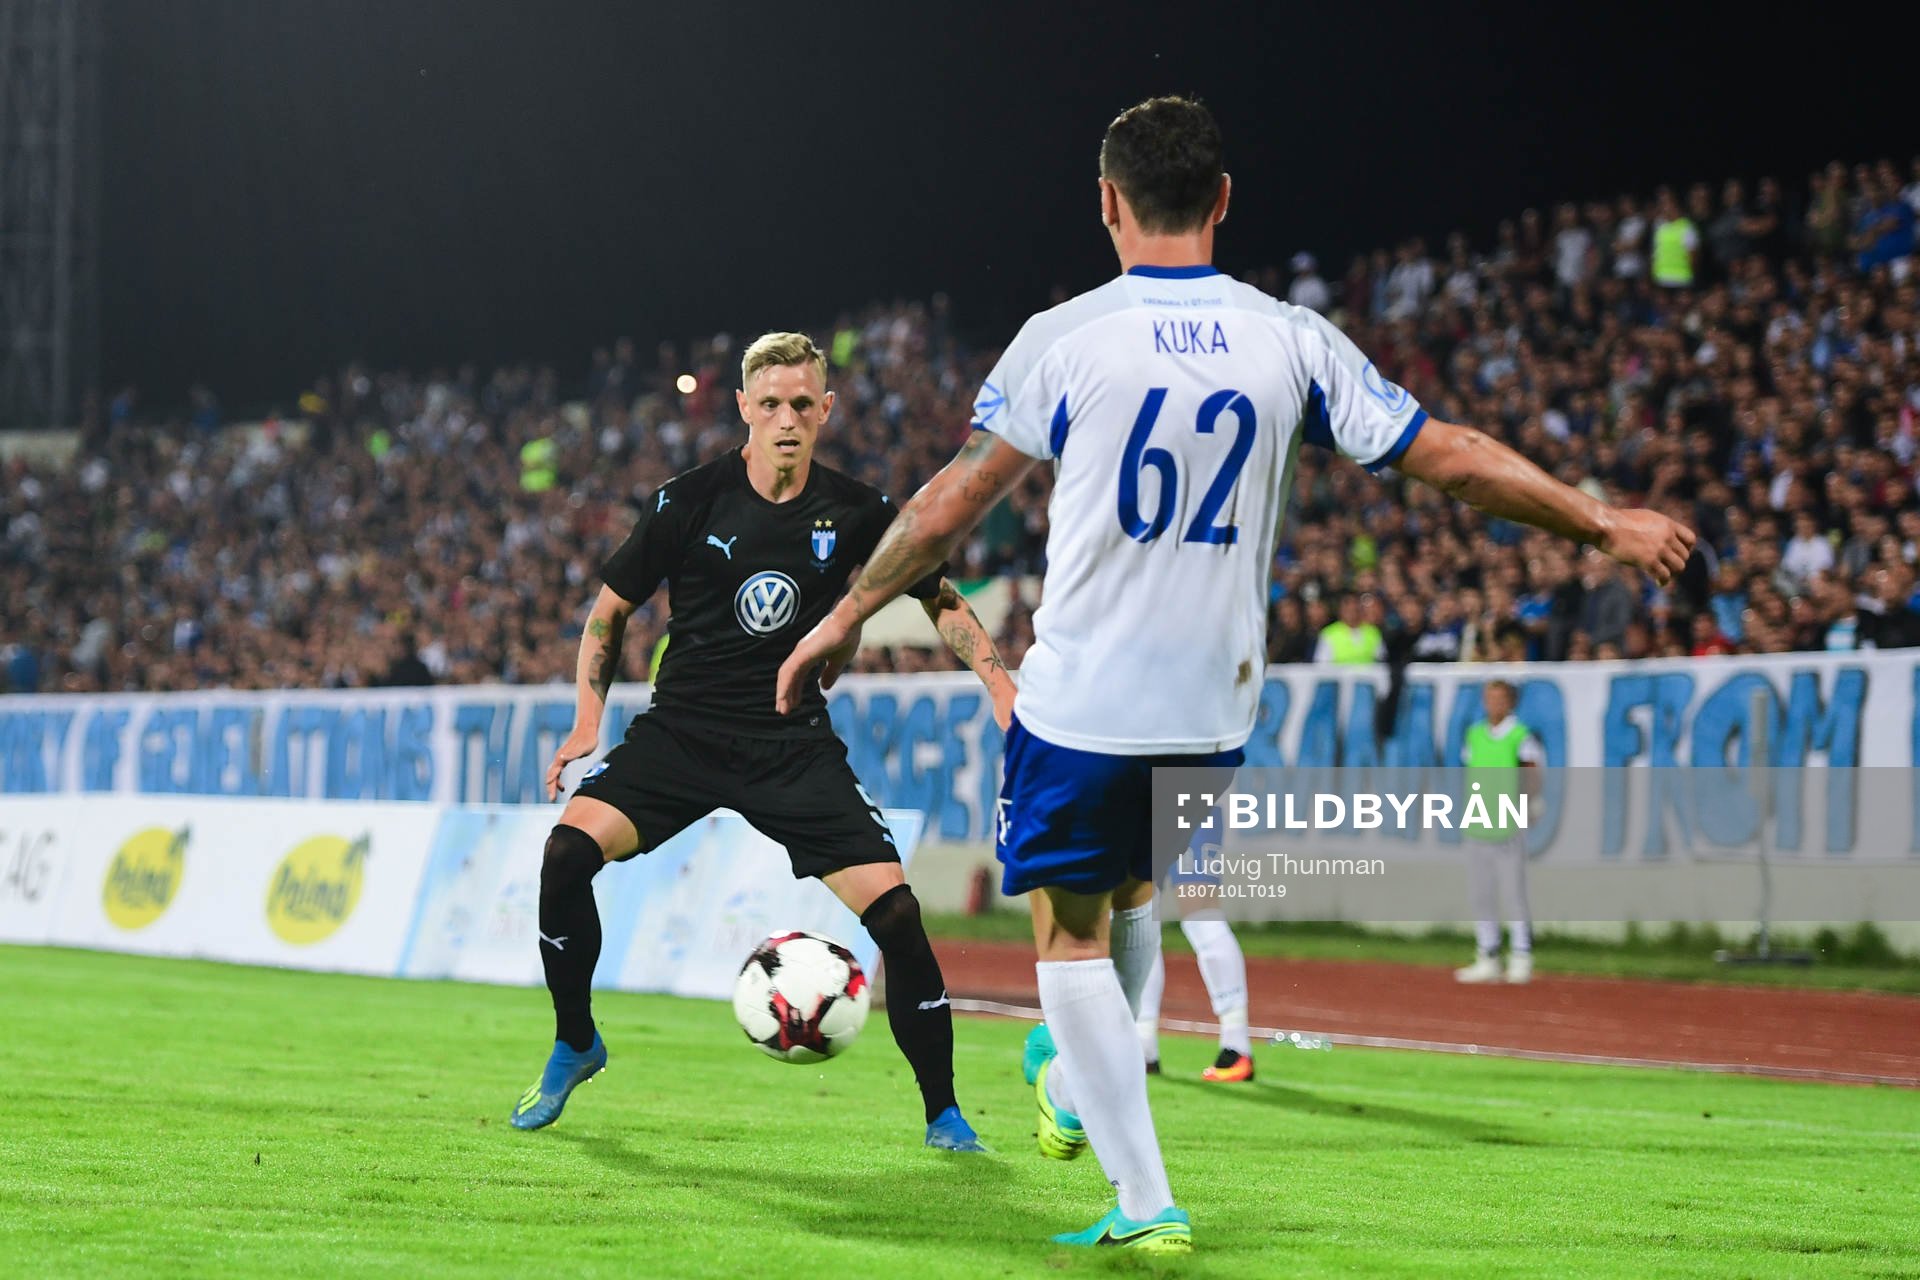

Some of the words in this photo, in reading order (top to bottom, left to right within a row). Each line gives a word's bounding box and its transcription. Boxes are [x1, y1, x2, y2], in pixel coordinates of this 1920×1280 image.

[1153, 320, 1229, 354] KUKA
[1117, 387, 1258, 545] 62
[1601, 666, 1869, 855] FROM
